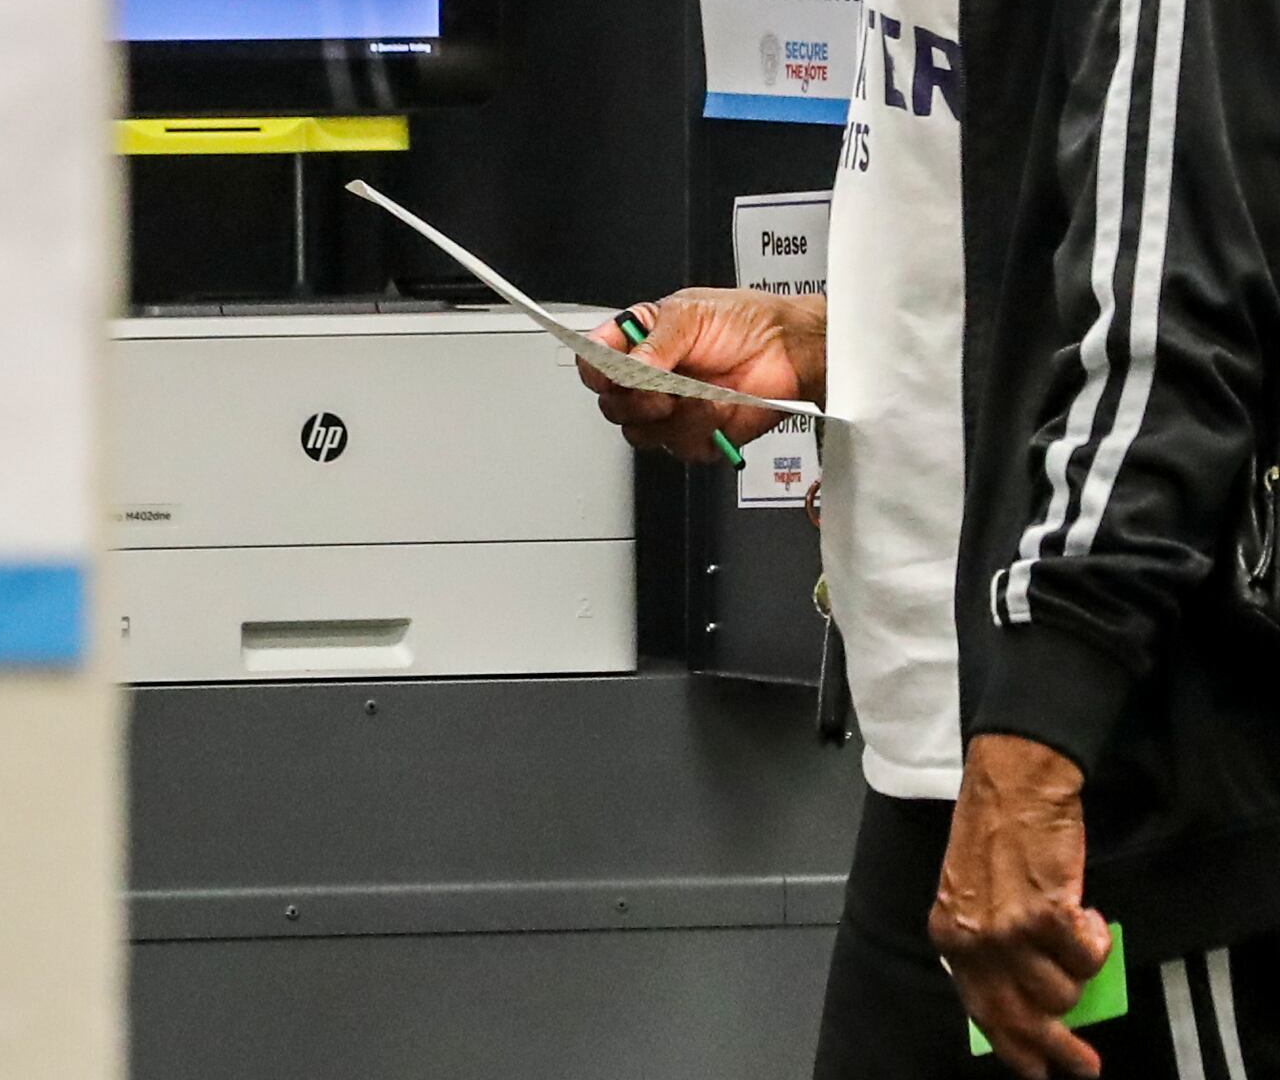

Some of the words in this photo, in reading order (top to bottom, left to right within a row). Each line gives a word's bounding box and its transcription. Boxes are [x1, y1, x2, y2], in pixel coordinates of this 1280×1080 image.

[785, 41, 828, 60] SECURE
[786, 64, 803, 80] THE
[762, 232, 808, 256] Please
[769, 414, 812, 434] orker
[307, 412, 343, 463] hp
